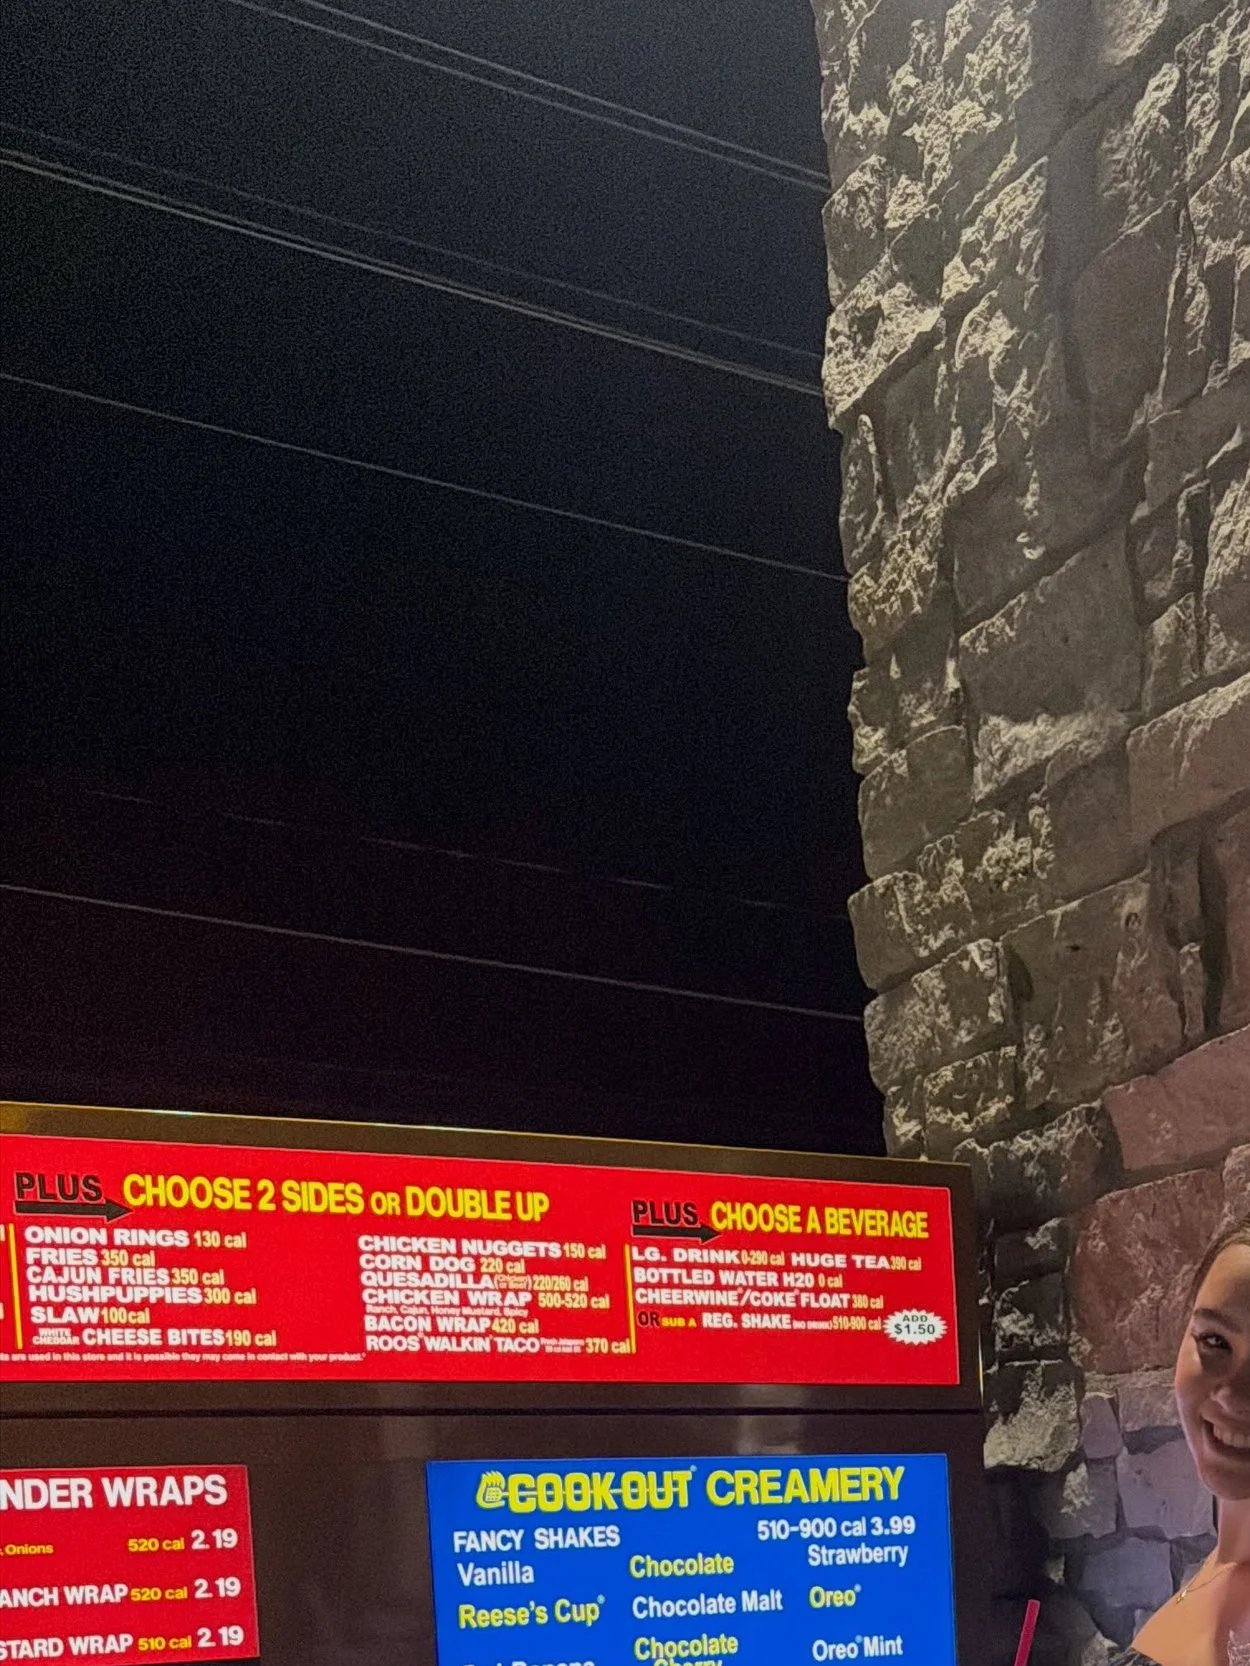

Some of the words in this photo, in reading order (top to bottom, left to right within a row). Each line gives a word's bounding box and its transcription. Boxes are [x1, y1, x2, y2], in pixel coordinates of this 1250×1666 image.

[15, 1173, 102, 1202] PLUS
[123, 1174, 251, 1210] CHOOSE
[258, 1179, 276, 1210] 2
[281, 1181, 364, 1214] SIDES
[370, 1192, 400, 1215] OR
[406, 1186, 512, 1221] DOUBLE
[517, 1192, 549, 1221] UP
[632, 1200, 697, 1226] PLUS
[710, 1201, 801, 1232] CHOOSE
[807, 1206, 821, 1234] A
[825, 1206, 928, 1238] BEVERAGE
[24, 1227, 107, 1246] ONION
[118, 1229, 190, 1248] RINGS
[194, 1231, 221, 1248] 130
[224, 1231, 246, 1248] cal
[358, 1236, 456, 1254] CHICKEN
[461, 1238, 562, 1258] NUGGETS
[564, 1242, 585, 1259] 150
[587, 1242, 606, 1260] cal
[632, 1247, 666, 1262] LG.
[673, 1249, 739, 1264] DRINK
[770, 1251, 785, 1267] cal
[791, 1252, 847, 1268] HUGE
[852, 1254, 890, 1269] TEA
[890, 1256, 907, 1270] 390
[908, 1256, 921, 1270] cal
[29, 1285, 202, 1304] HUSHPUPPIES
[204, 1288, 230, 1304] 300
[234, 1288, 257, 1304] cal
[702, 1313, 737, 1328] REG.
[741, 1314, 791, 1329] SHAKE
[894, 1323, 936, 1336] $1.50
[902, 1314, 928, 1323] ADD
[102, 1474, 228, 1507] WRAPS
[706, 1466, 904, 1507] CREAMERY
[453, 1529, 523, 1552] FANCY
[535, 1525, 620, 1548] SHAKES
[757, 1519, 836, 1541] 510-900
[841, 1517, 866, 1537] cal
[871, 1515, 915, 1535] 3.99
[7, 1543, 53, 1554] Onions
[128, 1538, 159, 1551] 520
[163, 1537, 185, 1550] cal
[808, 1544, 908, 1568] Strawberry
[458, 1562, 535, 1586] Vanilla
[630, 1555, 734, 1577] Chocolate
[864, 1636, 903, 1657] Mint
